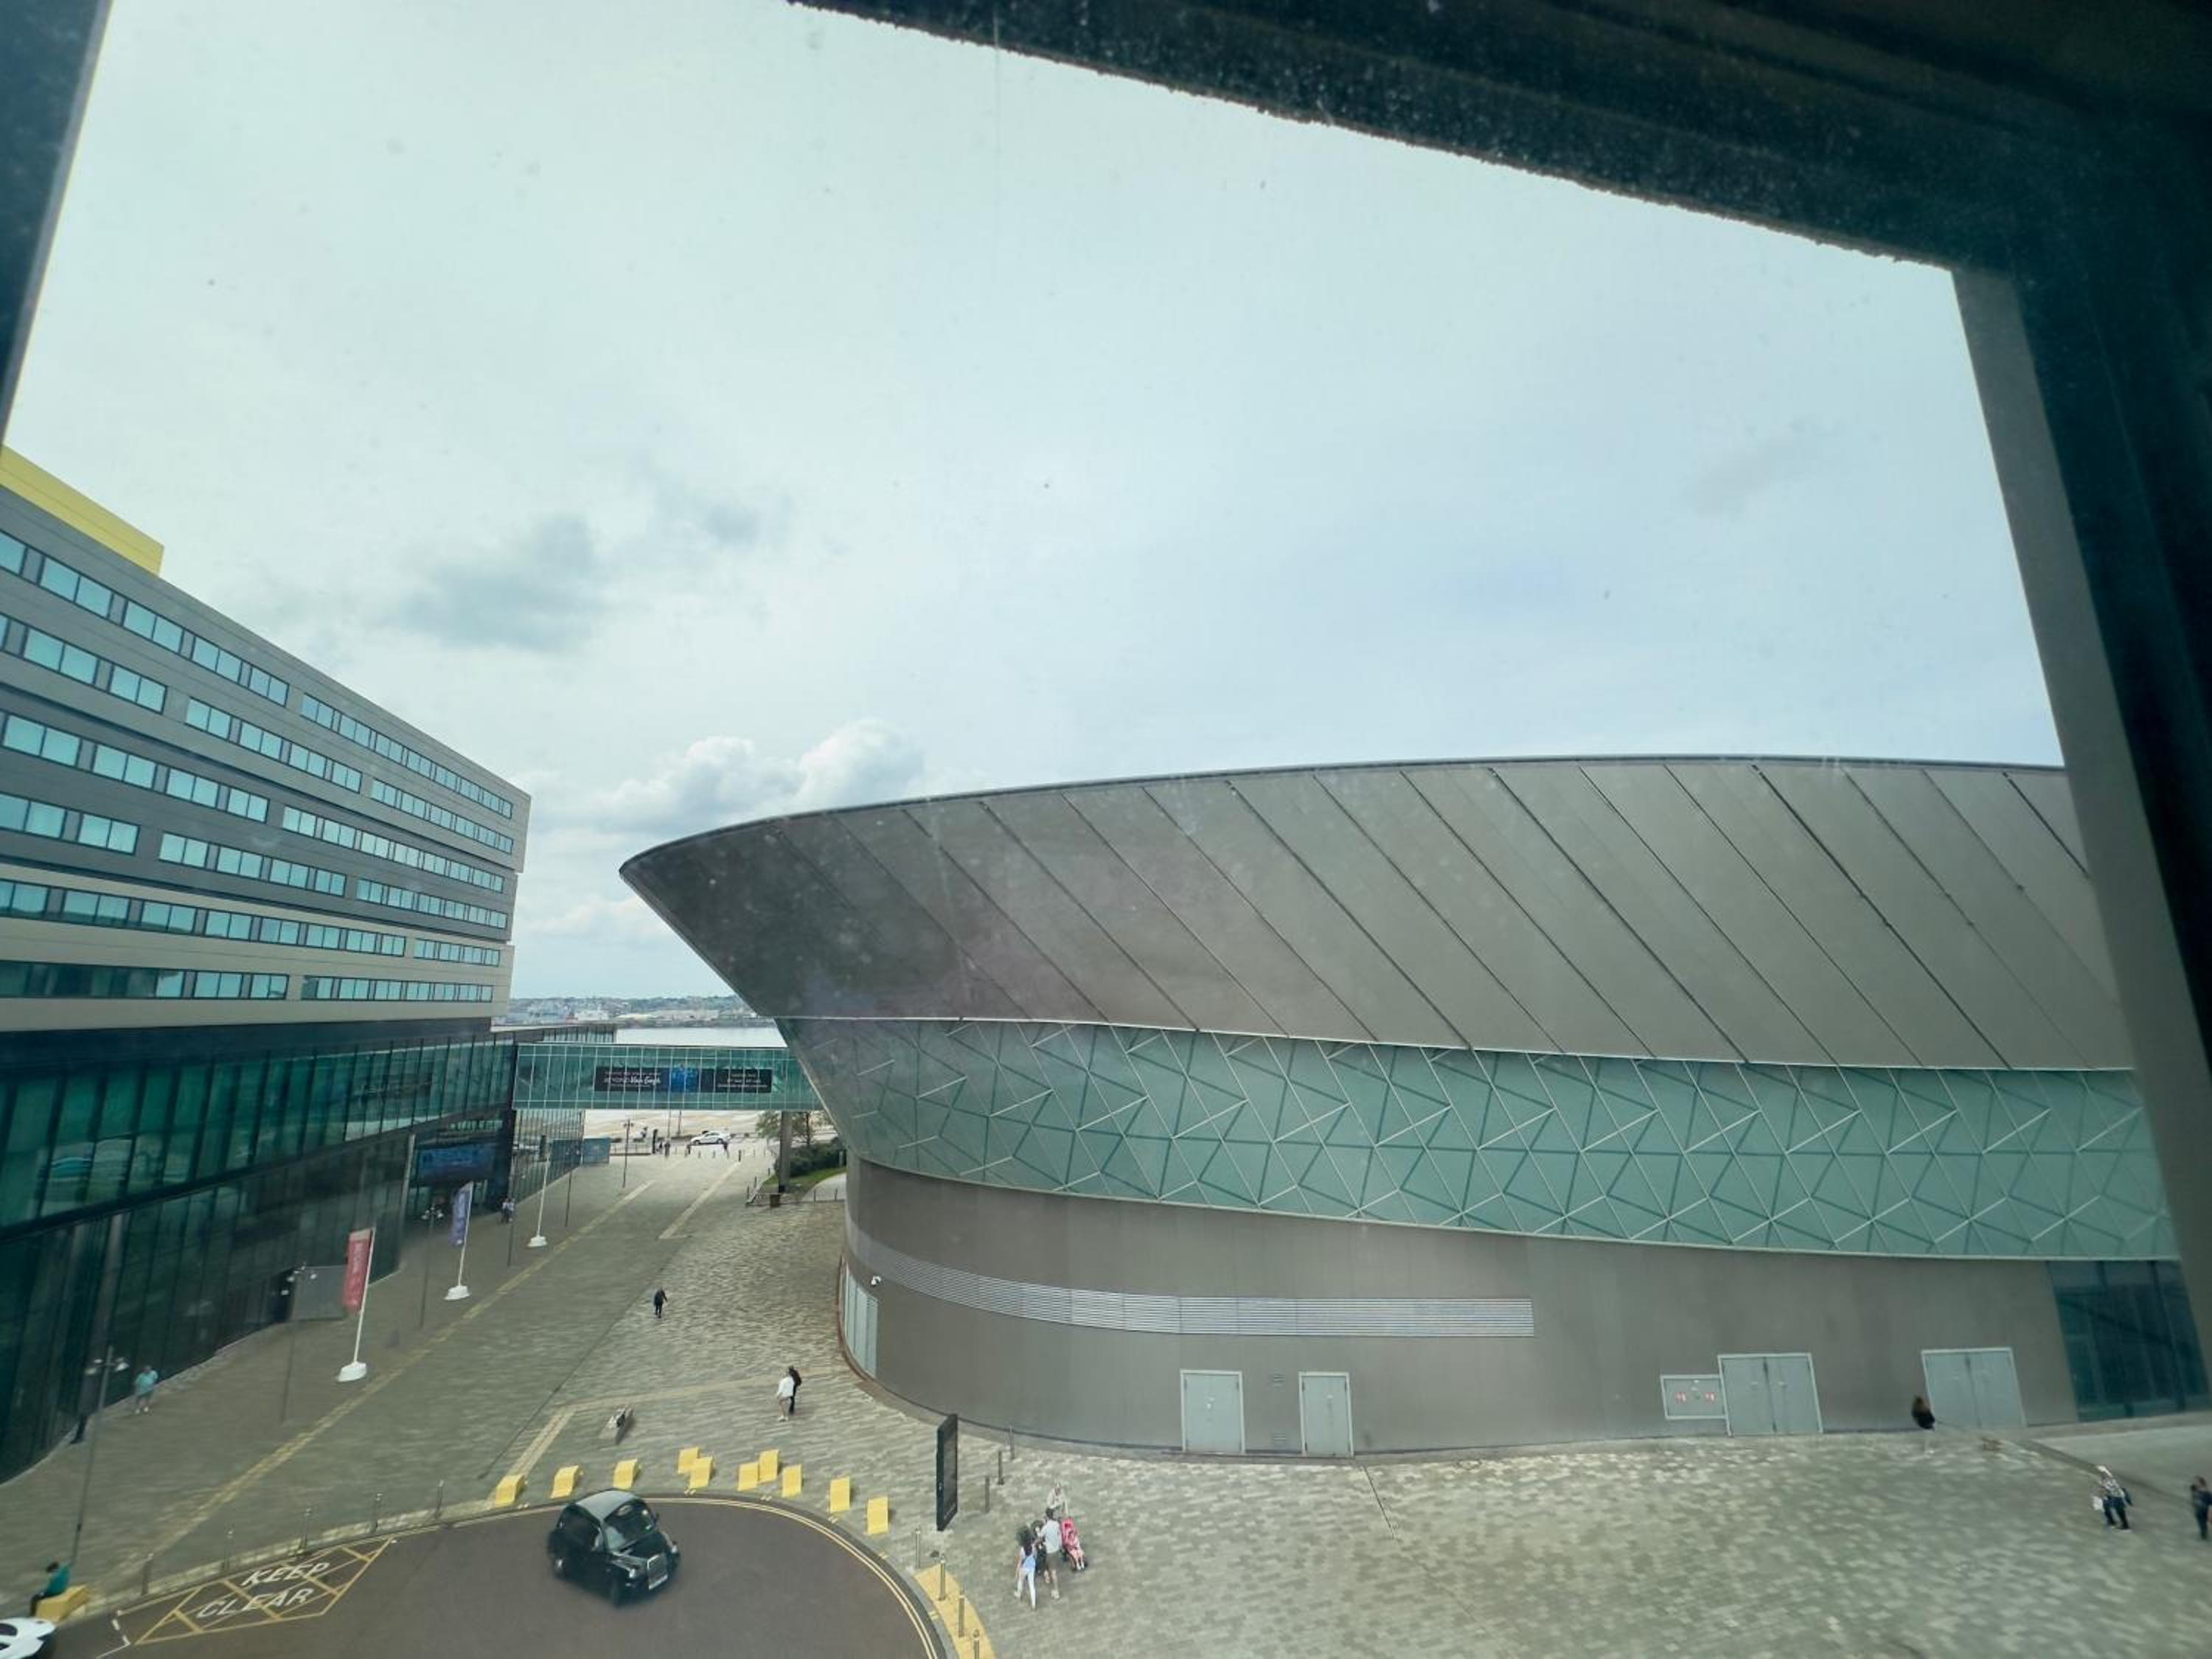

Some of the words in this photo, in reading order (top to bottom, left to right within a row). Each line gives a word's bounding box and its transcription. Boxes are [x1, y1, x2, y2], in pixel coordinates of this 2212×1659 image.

[644, 1076, 661, 1085] Gogh
[241, 1562, 330, 1587] KEEP
[197, 1587, 315, 1618] CLEAR
